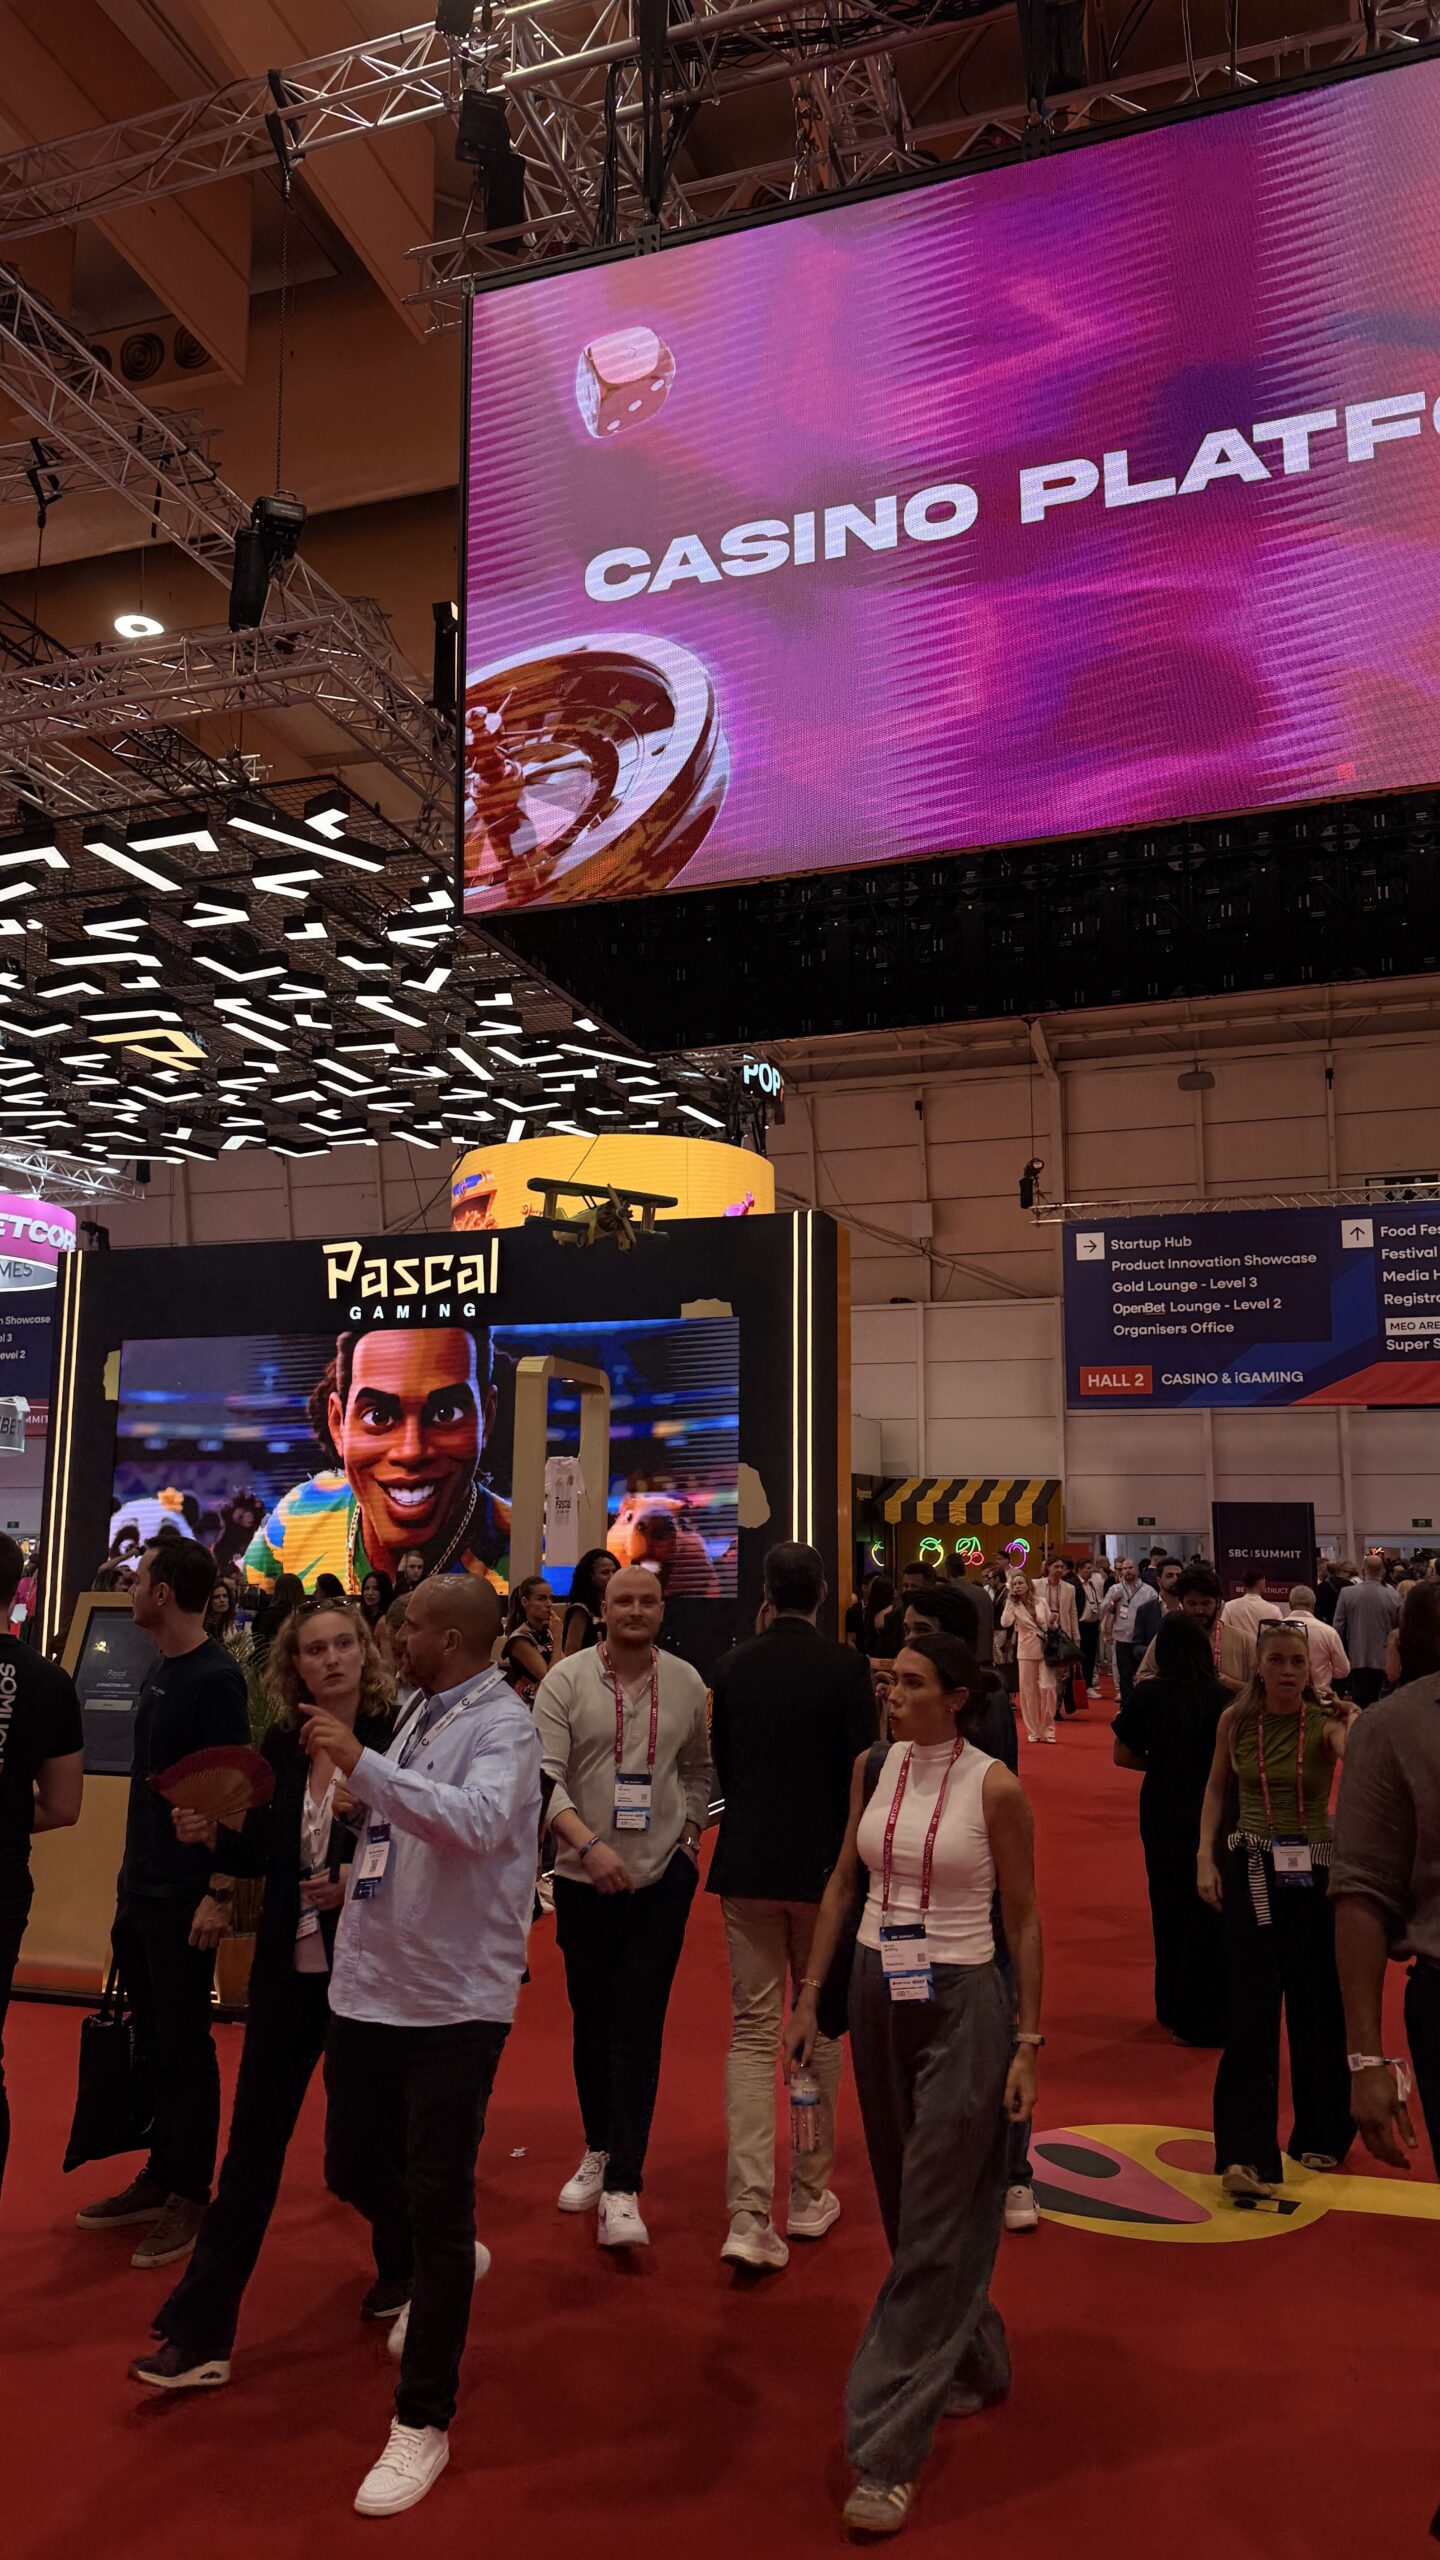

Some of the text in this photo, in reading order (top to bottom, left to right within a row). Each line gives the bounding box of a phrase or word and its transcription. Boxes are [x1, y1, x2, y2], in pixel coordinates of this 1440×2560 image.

[585, 390, 1440, 600] CASINO PLATF
[743, 1054, 784, 1102] POP
[1380, 1224, 1416, 1237] Food
[1111, 1236, 1192, 1251] Startup Hub
[1381, 1246, 1438, 1260] Festival
[322, 1237, 499, 1299] Pascal
[1111, 1253, 1317, 1272] Product Innovation Showcase
[1383, 1269, 1430, 1283] Media
[1112, 1281, 1144, 1293] Gold
[1147, 1279, 1198, 1294] Lounge
[1210, 1277, 1246, 1290] Level
[1249, 1276, 1258, 1288] 3
[349, 1302, 476, 1320] GAMING
[1113, 1302, 1166, 1315] OpenBet
[1170, 1301, 1221, 1314] Lounge
[1233, 1298, 1270, 1311] Level
[1273, 1297, 1282, 1309] 2
[5, 1315, 51, 1326] Showcase
[1390, 1322, 1416, 1331] MEO
[1113, 1321, 1235, 1337] Organisers Office
[7, 1333, 13, 1342] 3
[1386, 1339, 1430, 1352] Super
[20, 1350, 26, 1359] 2
[1088, 1371, 1304, 1387] HALL 2 CASINO & iGAMING
[0, 1416, 21, 1434] BET
